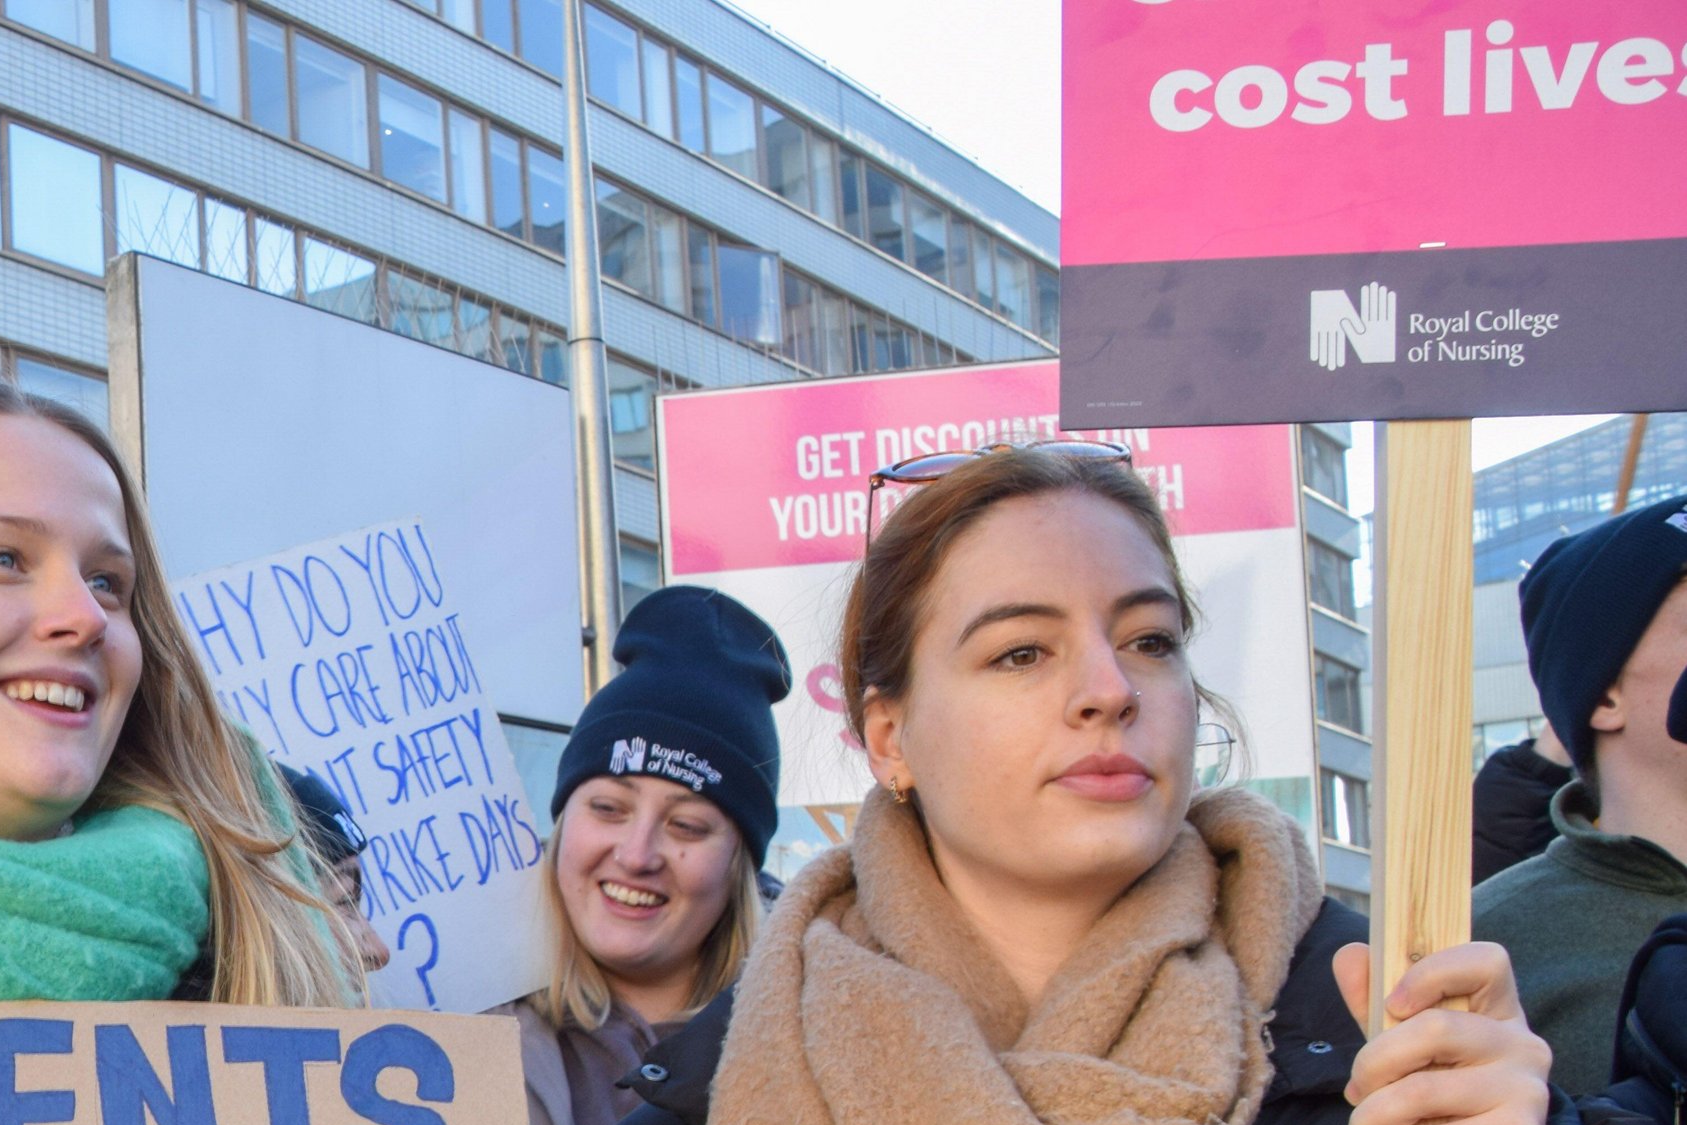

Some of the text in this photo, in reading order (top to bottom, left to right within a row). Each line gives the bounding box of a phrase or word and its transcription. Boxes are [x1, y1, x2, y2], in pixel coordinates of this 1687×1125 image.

[1149, 19, 1687, 132] cost live
[1407, 339, 1525, 367] of Nursing
[1409, 308, 1560, 341] Royal College
[796, 431, 865, 481] GET
[876, 414, 1085, 475] DISCOUNT
[769, 491, 869, 541] YOUR
[180, 524, 443, 676] HY DO YOU
[291, 644, 394, 738] CARE
[389, 613, 482, 717] ABOUT
[373, 708, 494, 806] SAFETY
[646, 759, 705, 792] of Nursing
[650, 743, 723, 785] Royal College
[459, 794, 543, 886] DAYS
[397, 913, 440, 1012] ?
